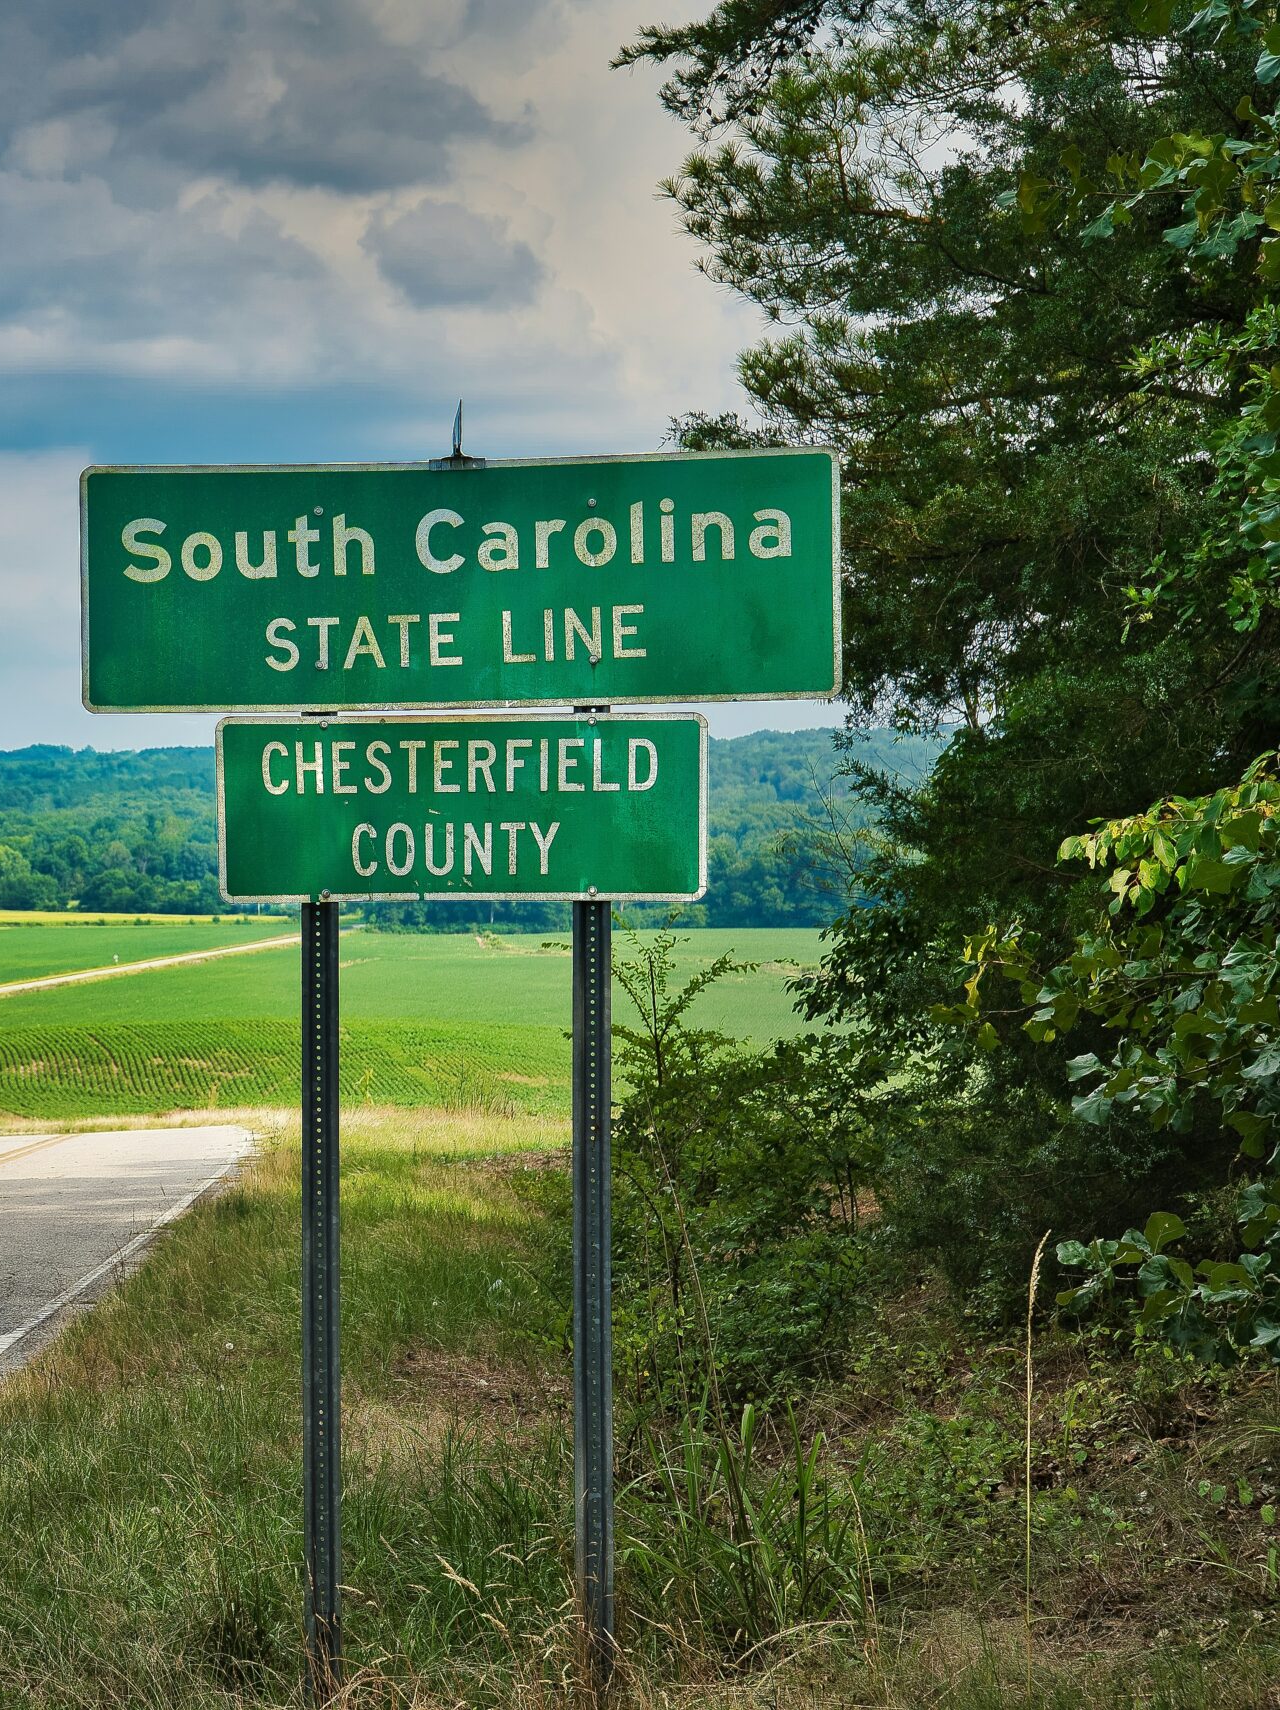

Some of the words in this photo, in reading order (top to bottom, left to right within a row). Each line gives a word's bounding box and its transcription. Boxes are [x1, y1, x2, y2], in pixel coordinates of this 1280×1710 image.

[121, 513, 375, 583] South
[415, 498, 792, 574] Carolina
[265, 612, 463, 672] STATE
[501, 604, 647, 663] LINE
[261, 738, 659, 796] CHESTERFIELD
[351, 821, 561, 877] COUNTY
